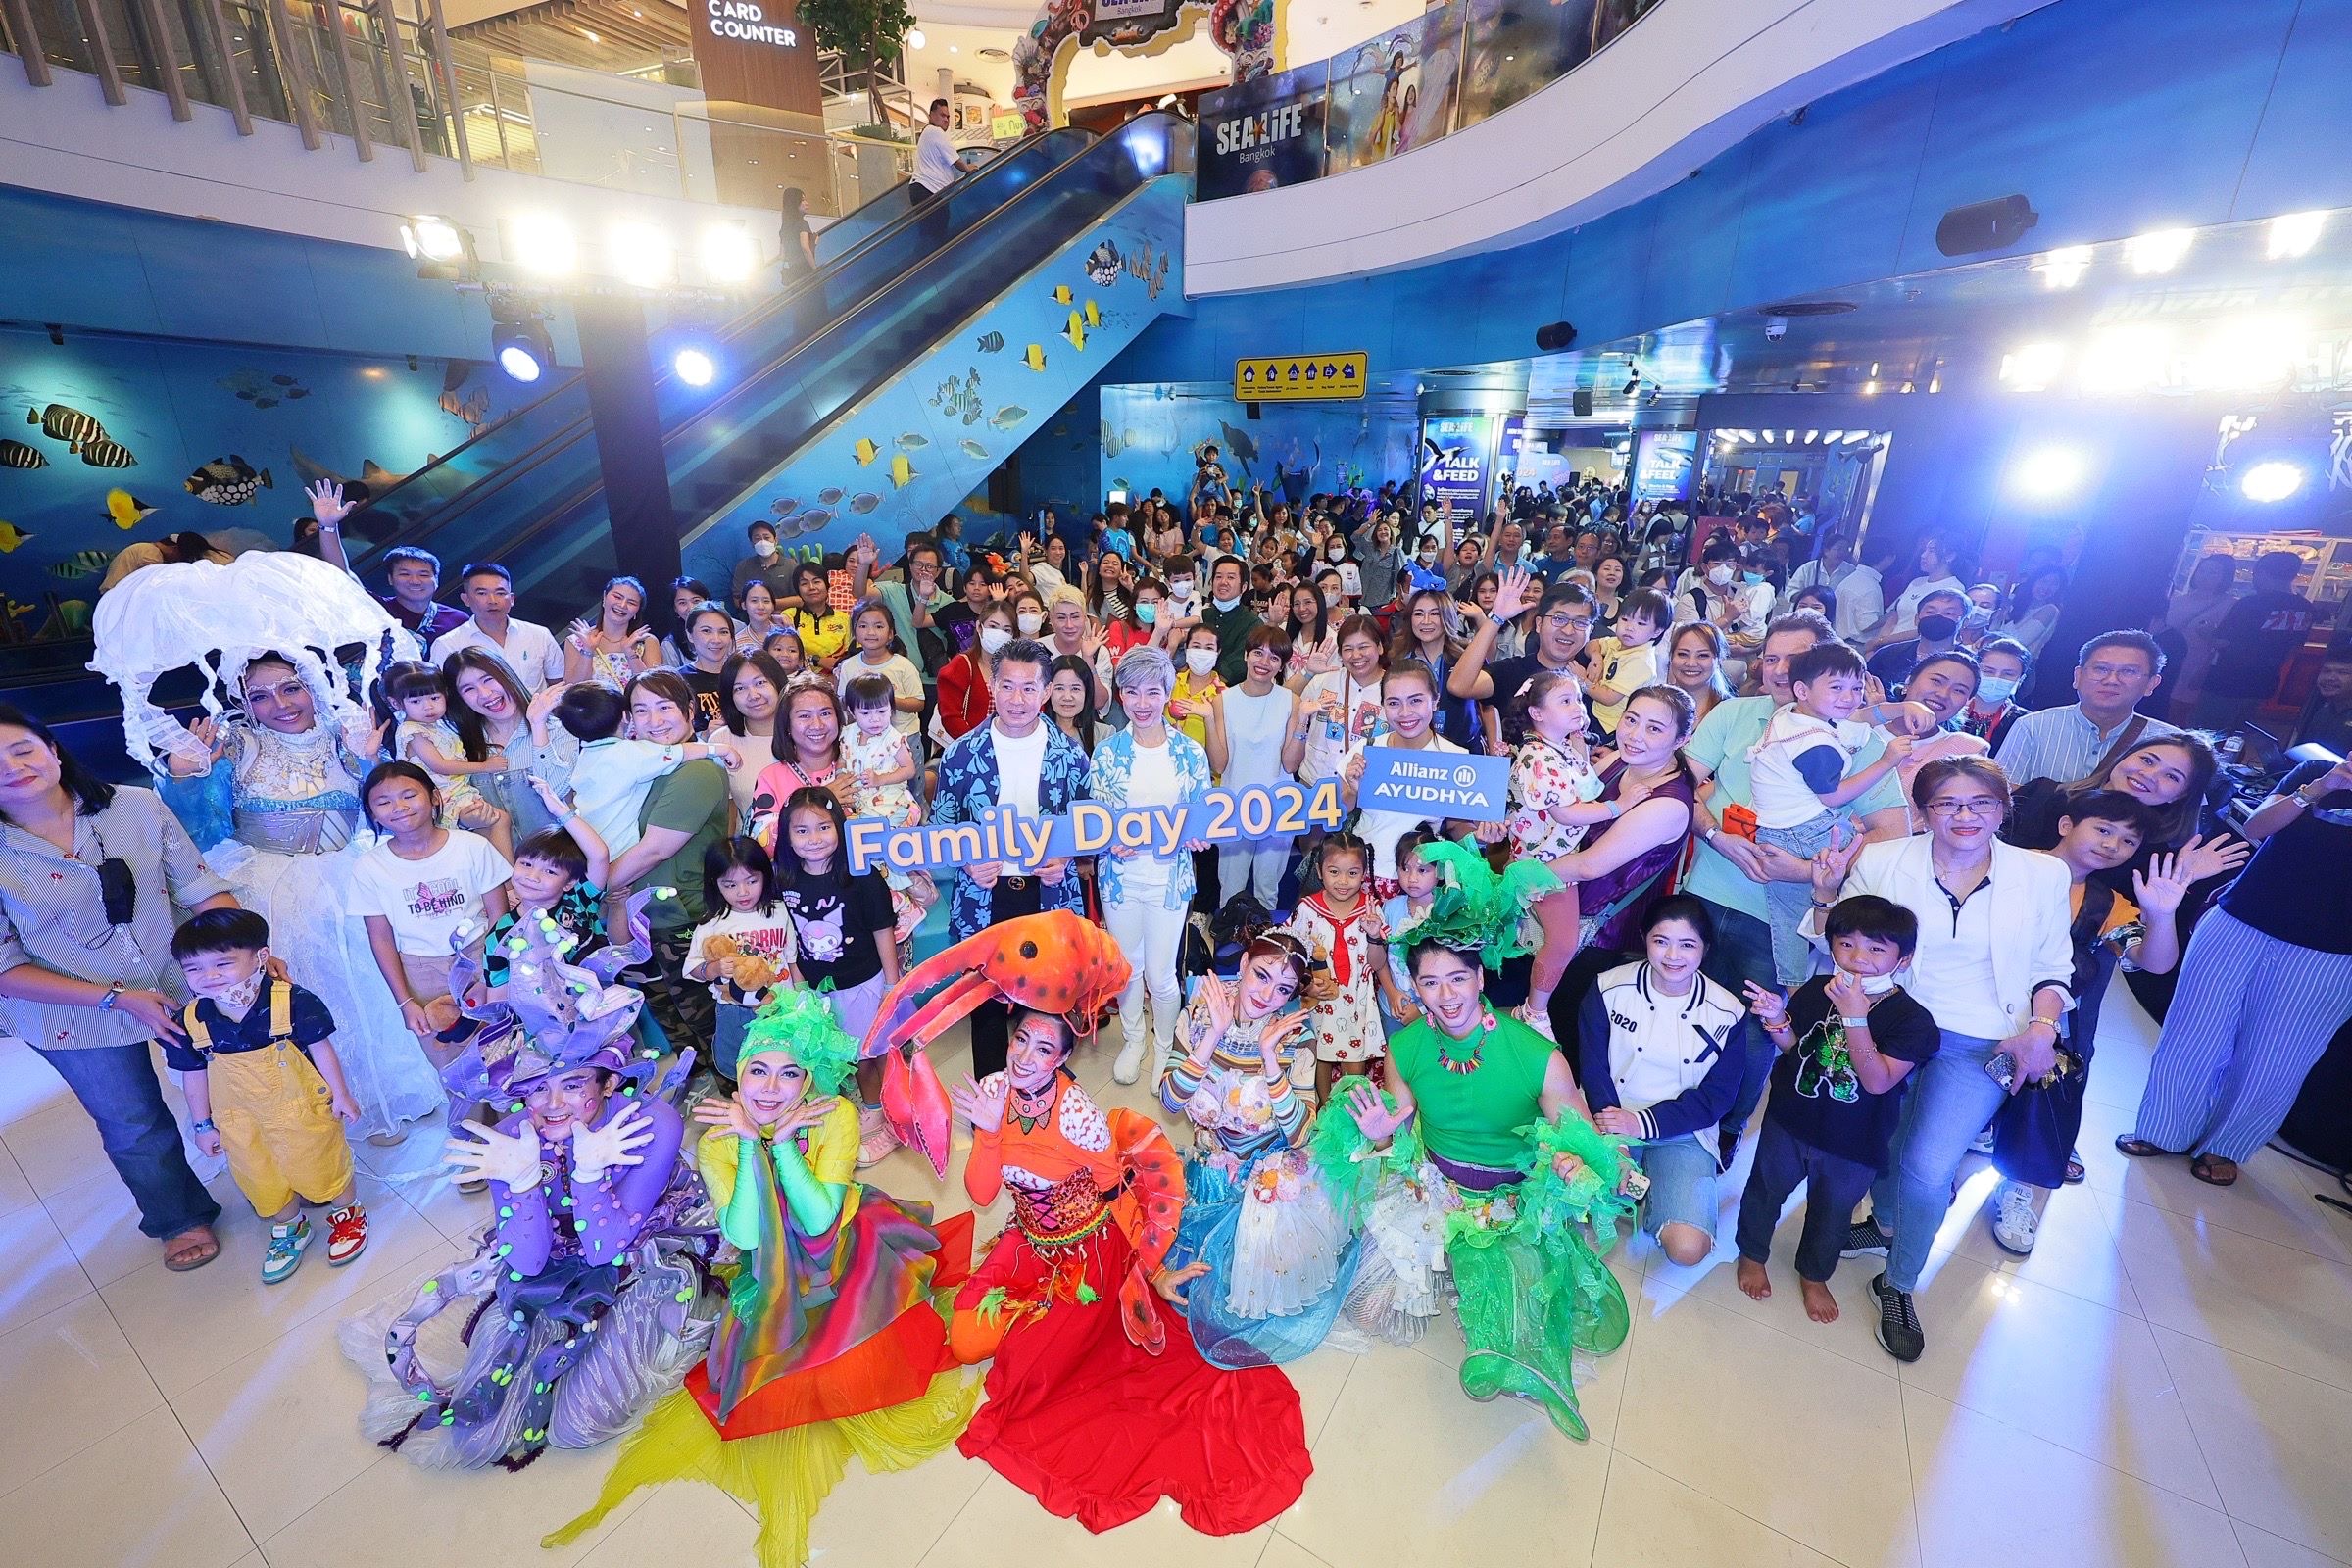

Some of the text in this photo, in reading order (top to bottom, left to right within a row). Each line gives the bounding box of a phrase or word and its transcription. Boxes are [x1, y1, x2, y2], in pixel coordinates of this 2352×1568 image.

[708, 0, 762, 22] CARD
[710, 19, 797, 47] COUNTER
[1216, 116, 1255, 156] SEA
[1239, 145, 1276, 164] Bangkok
[1445, 454, 1480, 469] TALK
[1650, 459, 1681, 469] TALK
[1432, 468, 1479, 482] &FEED
[1390, 761, 1448, 781] Allianz
[1374, 782, 1490, 808] AYUDHYA
[850, 783, 1342, 871] Family Day 2024
[1610, 1010, 1638, 1033] 2020
